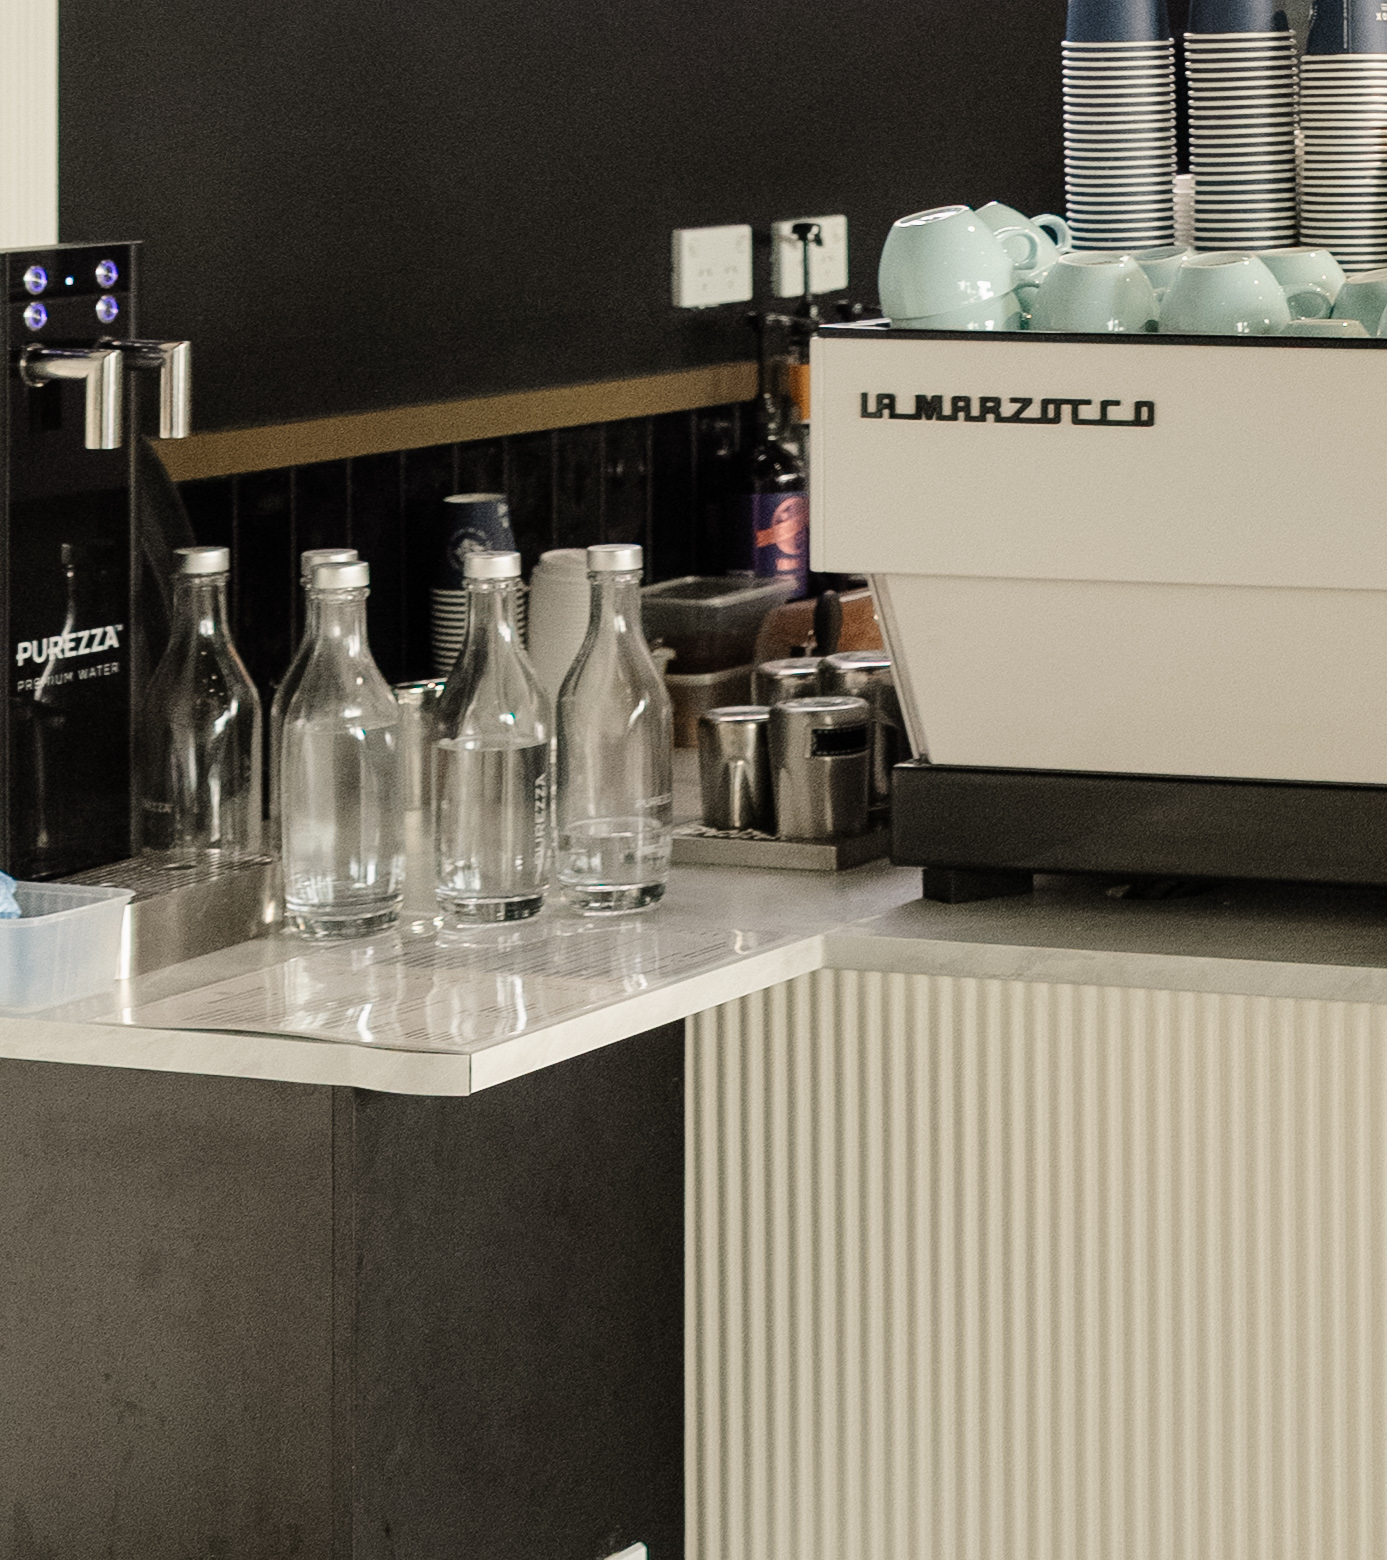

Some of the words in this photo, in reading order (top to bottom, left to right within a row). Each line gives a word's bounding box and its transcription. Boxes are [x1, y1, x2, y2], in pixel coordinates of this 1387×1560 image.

[914, 393, 1155, 427] MARZOCCO
[16, 624, 121, 667] PUREZZA
[78, 661, 121, 680] WATER
